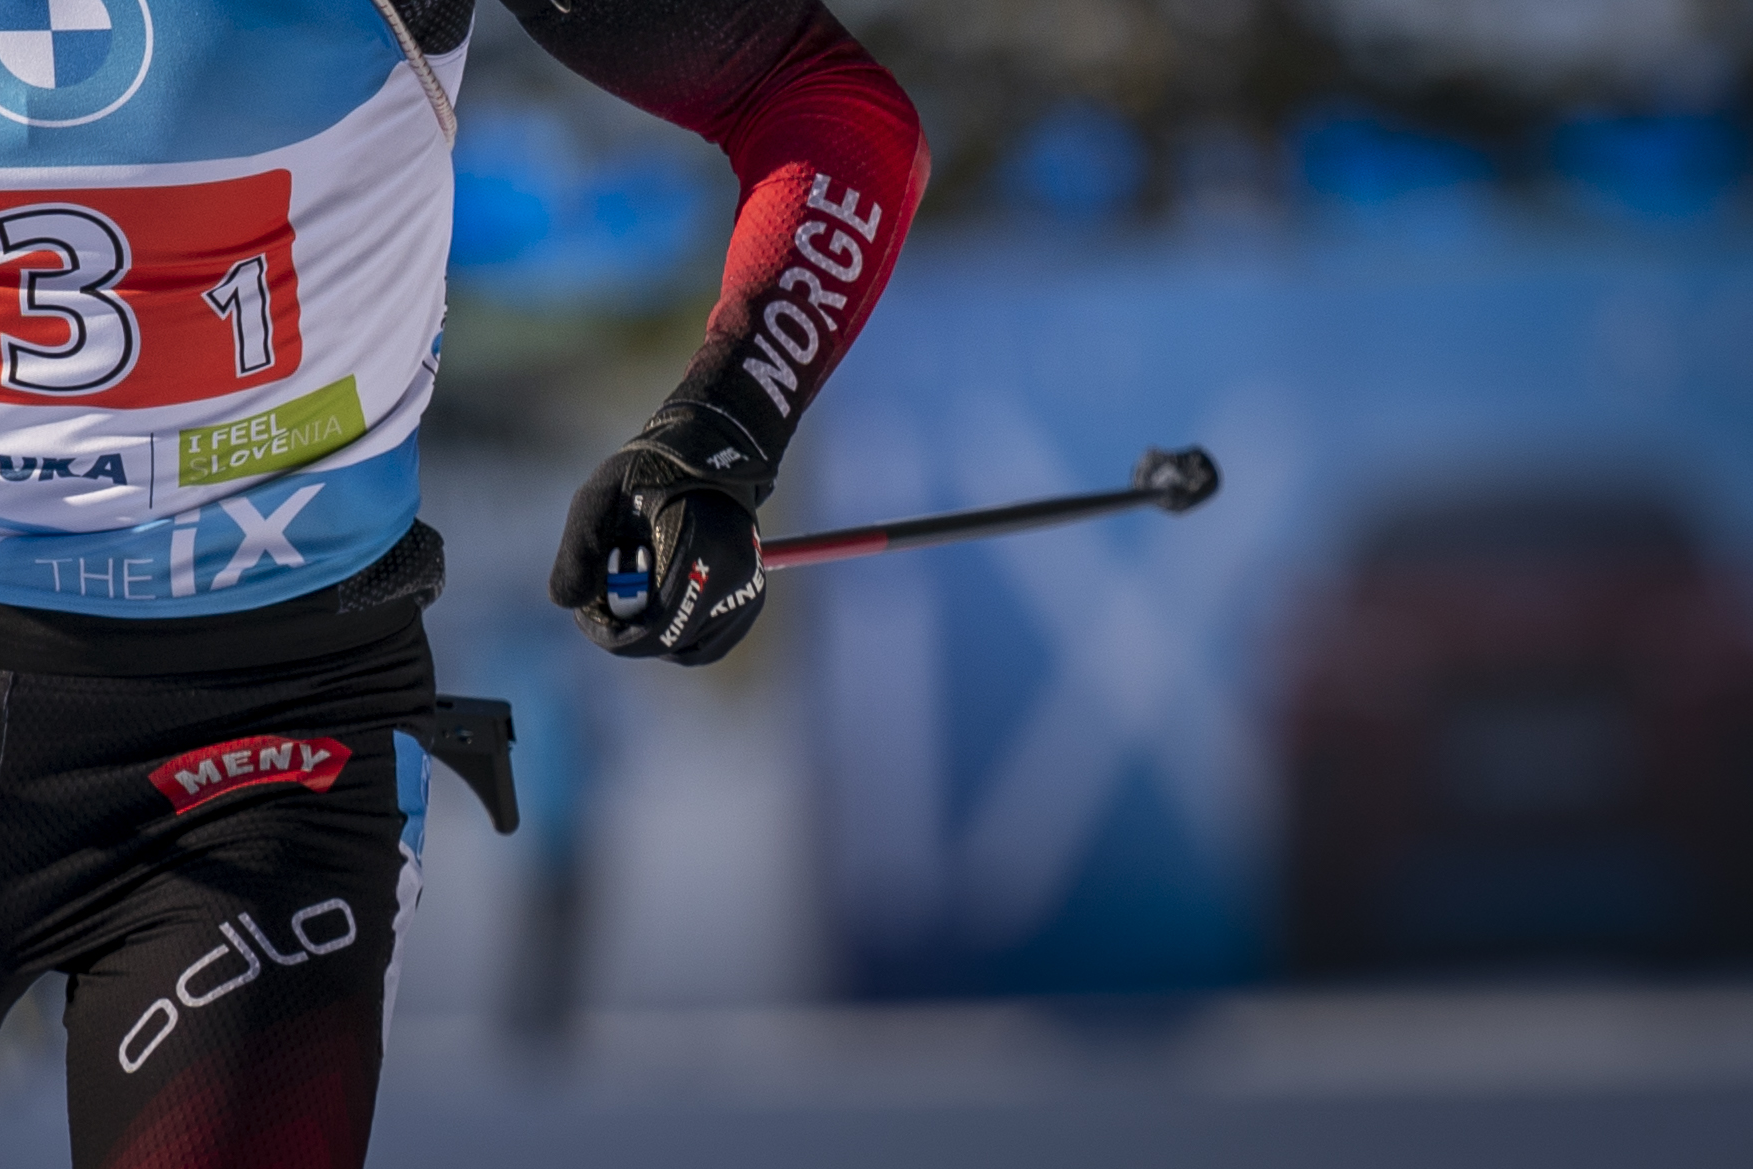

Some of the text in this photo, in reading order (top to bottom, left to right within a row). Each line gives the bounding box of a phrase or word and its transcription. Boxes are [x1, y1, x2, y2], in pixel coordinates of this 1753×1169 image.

[201, 252, 276, 378] 1
[743, 172, 883, 419] NORGE
[188, 413, 286, 454] I FEEL
[189, 415, 343, 481] SLOVENIA
[35, 557, 156, 600] THE
[174, 741, 331, 795] MENY
